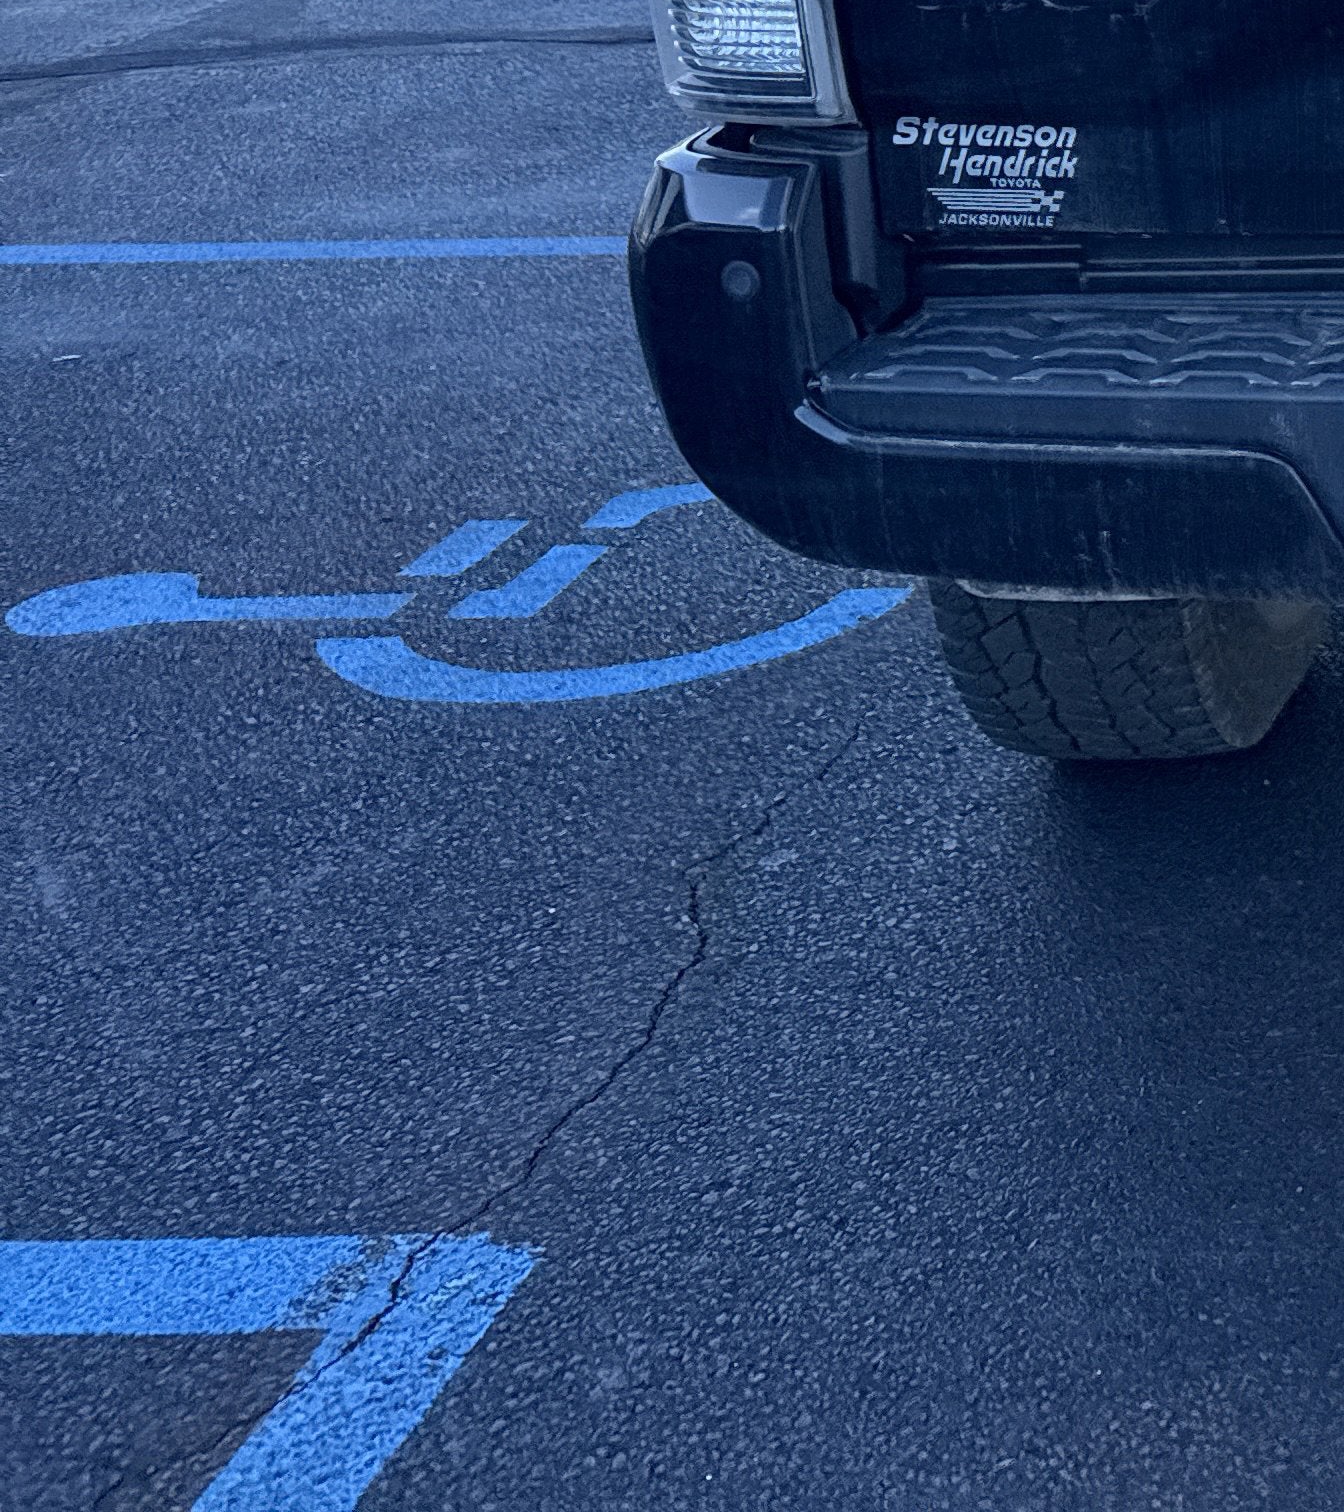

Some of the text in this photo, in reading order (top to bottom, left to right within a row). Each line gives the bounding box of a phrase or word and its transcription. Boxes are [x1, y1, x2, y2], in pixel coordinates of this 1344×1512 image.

[892, 116, 1077, 148] Stevenson
[938, 148, 1079, 184] Hendrick
[990, 178, 1041, 188] TOYOTA
[939, 213, 1055, 227] JACKSONVILLE
